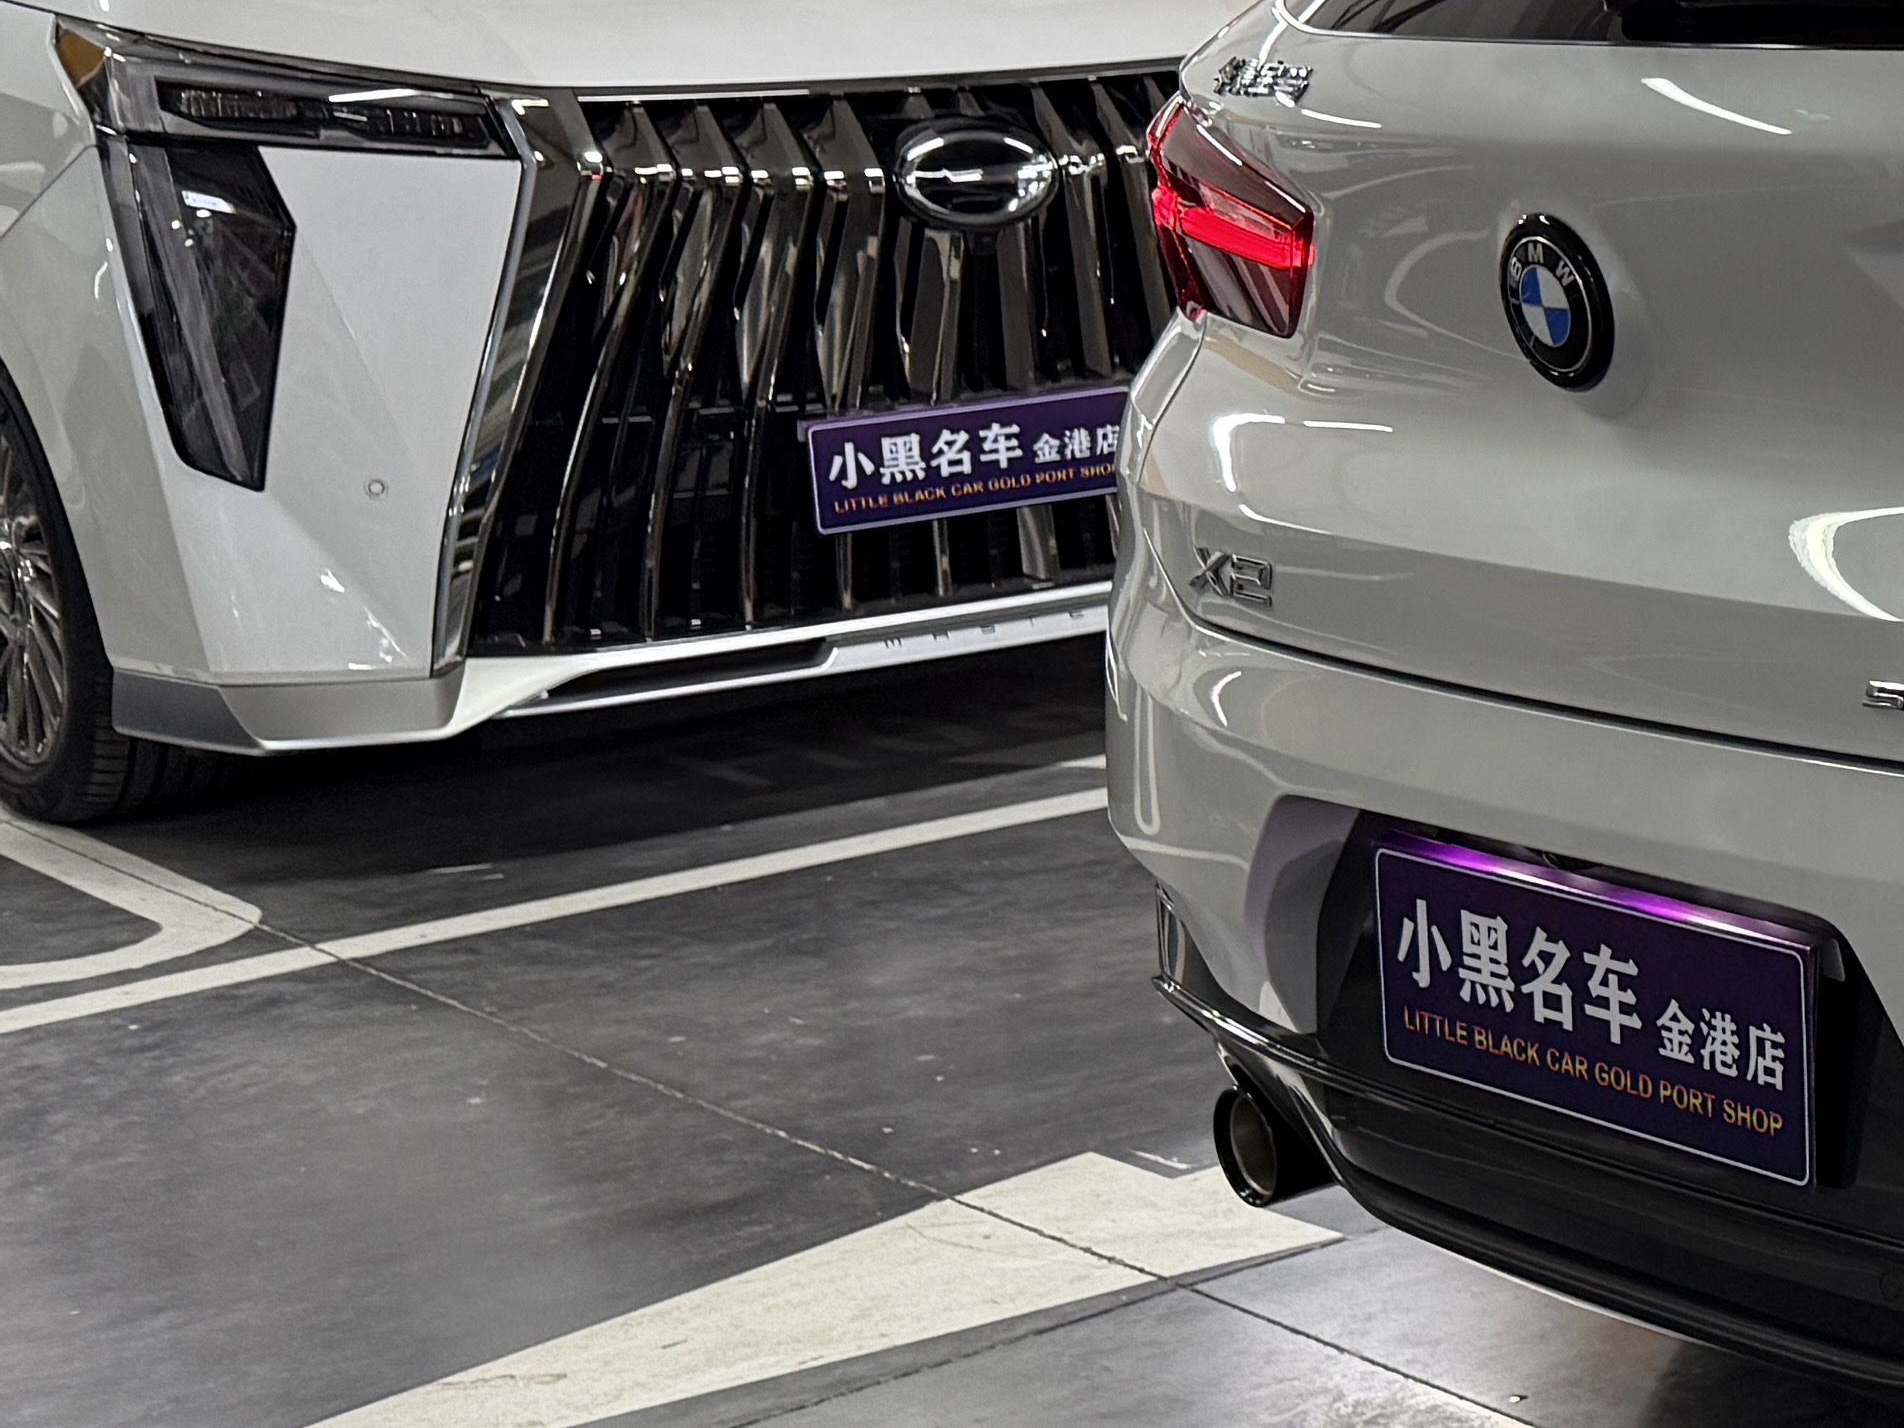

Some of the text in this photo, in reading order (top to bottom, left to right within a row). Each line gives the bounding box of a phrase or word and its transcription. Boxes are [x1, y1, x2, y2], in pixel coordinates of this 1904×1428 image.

[1508, 242, 1576, 289] BMW
[828, 422, 1120, 490] 小黑名车 金港店
[833, 494, 889, 515] LITTLE
[892, 486, 946, 505] BLACK
[950, 481, 985, 497] CAR
[987, 475, 1032, 493] GOLD
[1035, 469, 1076, 485] PORT
[1188, 547, 1273, 608] X2
[1398, 898, 1786, 1091] 小黑名车 金港店
[1403, 1006, 1784, 1137] LITTLE BLACK CAR GOLD PORT SHOP
